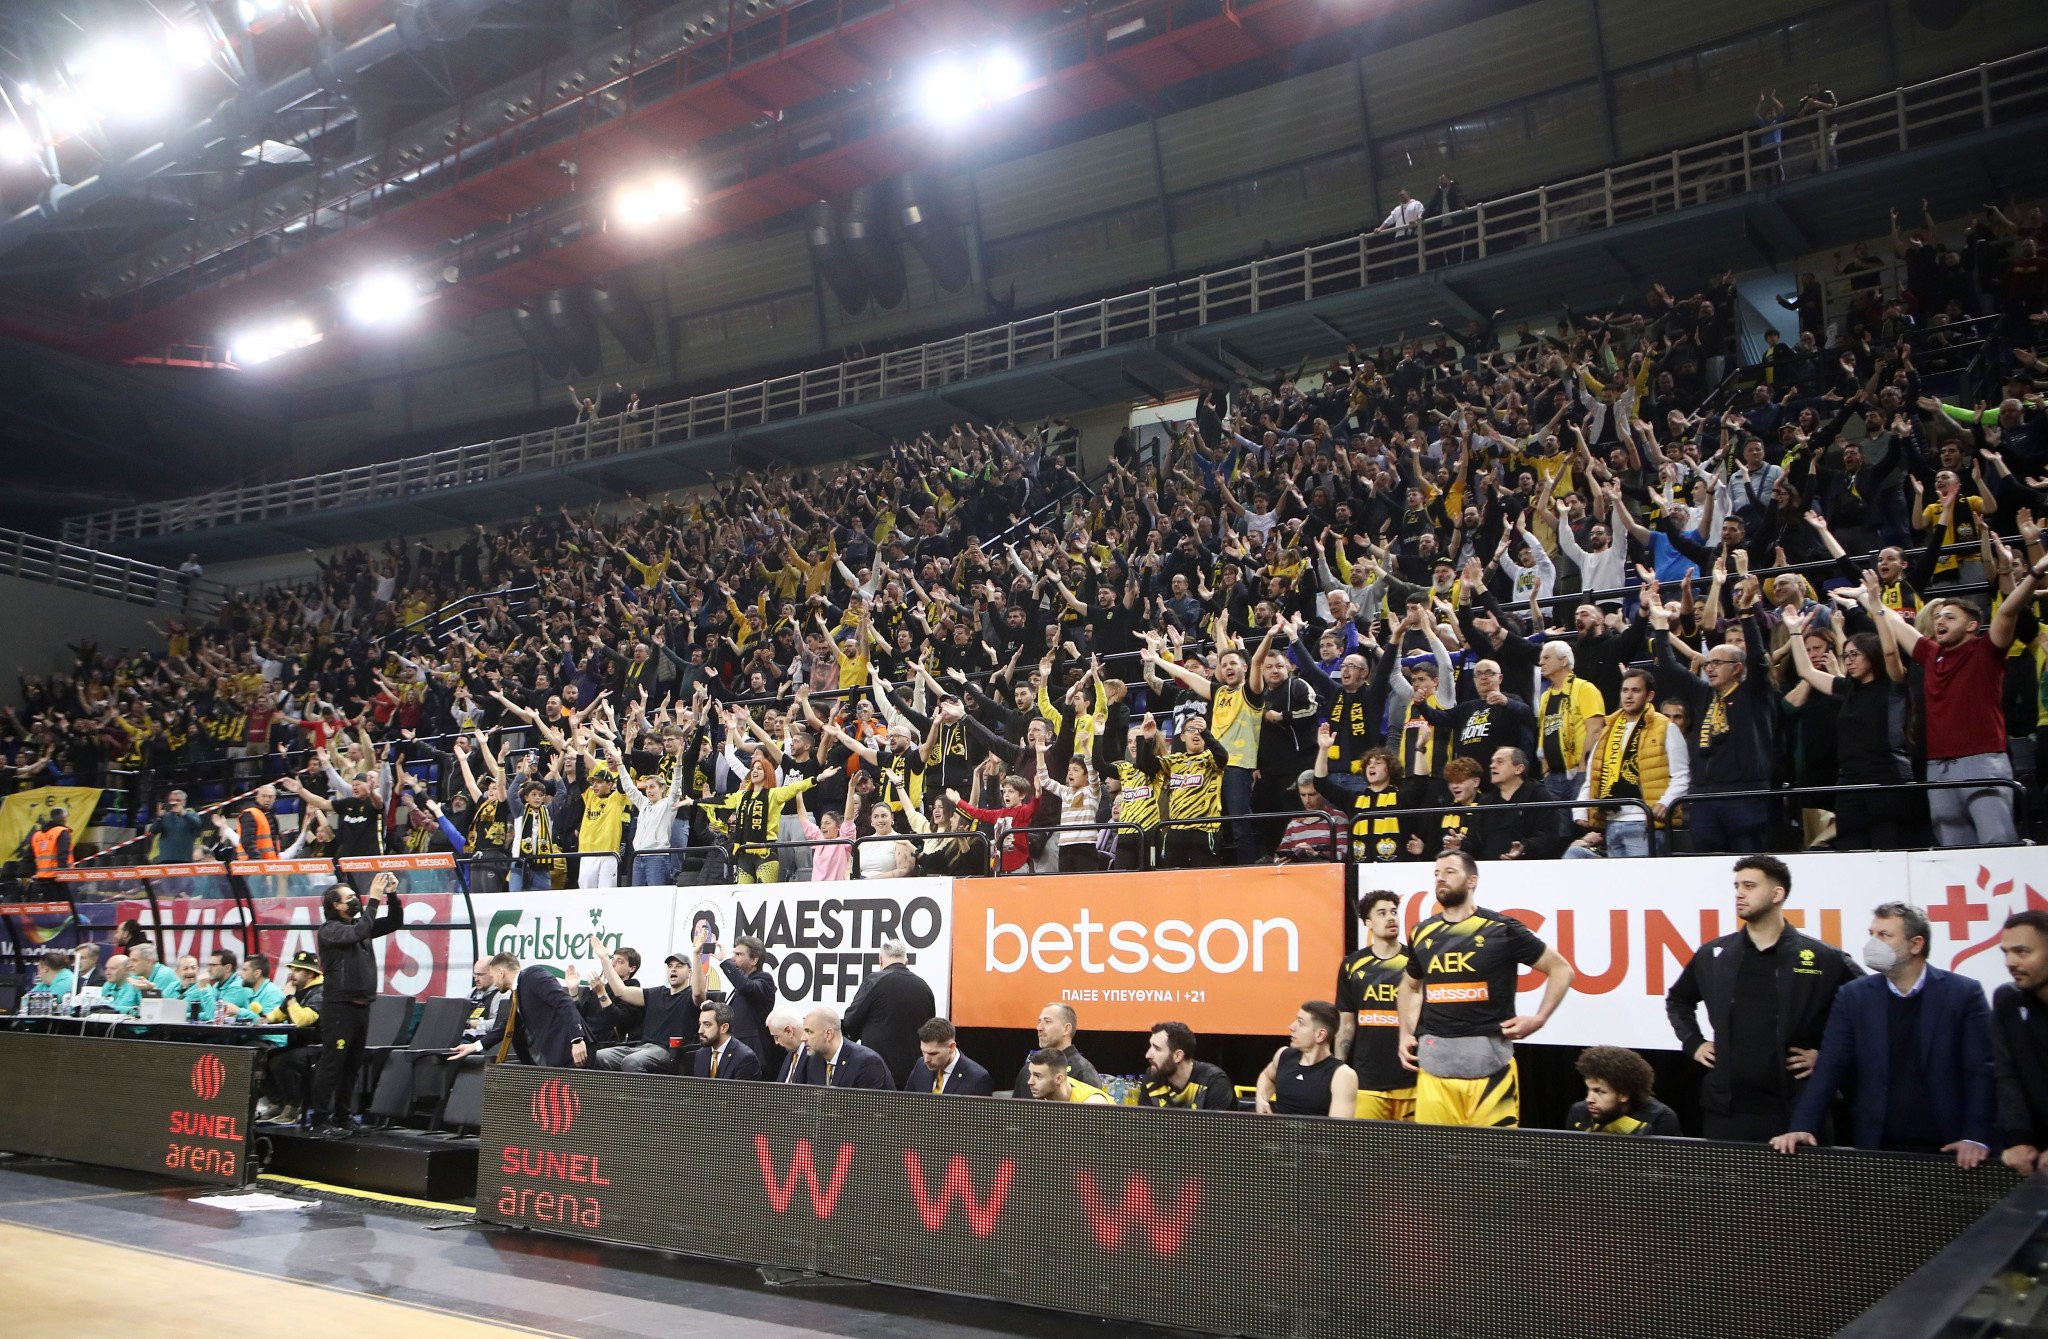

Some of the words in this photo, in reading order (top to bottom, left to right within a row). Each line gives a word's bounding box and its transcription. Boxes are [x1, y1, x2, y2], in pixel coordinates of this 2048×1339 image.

[1460, 722, 1492, 742] HOME
[416, 856, 450, 868] betsson
[734, 897, 942, 950] MAESTRO
[986, 908, 1299, 974] betsson
[1427, 951, 1476, 974] AEK
[1062, 990, 1098, 1002] ΠΑΙΞΕ
[1102, 990, 1172, 1003] ΥΠΕΥΘΥΝΑ
[1184, 991, 1206, 1003] +21
[169, 1110, 243, 1142] SUNEL
[165, 1142, 235, 1177] arena
[502, 1145, 610, 1187] SUNEL
[755, 1134, 855, 1220] W
[904, 1149, 1014, 1237] W
[498, 1187, 602, 1229] arena
